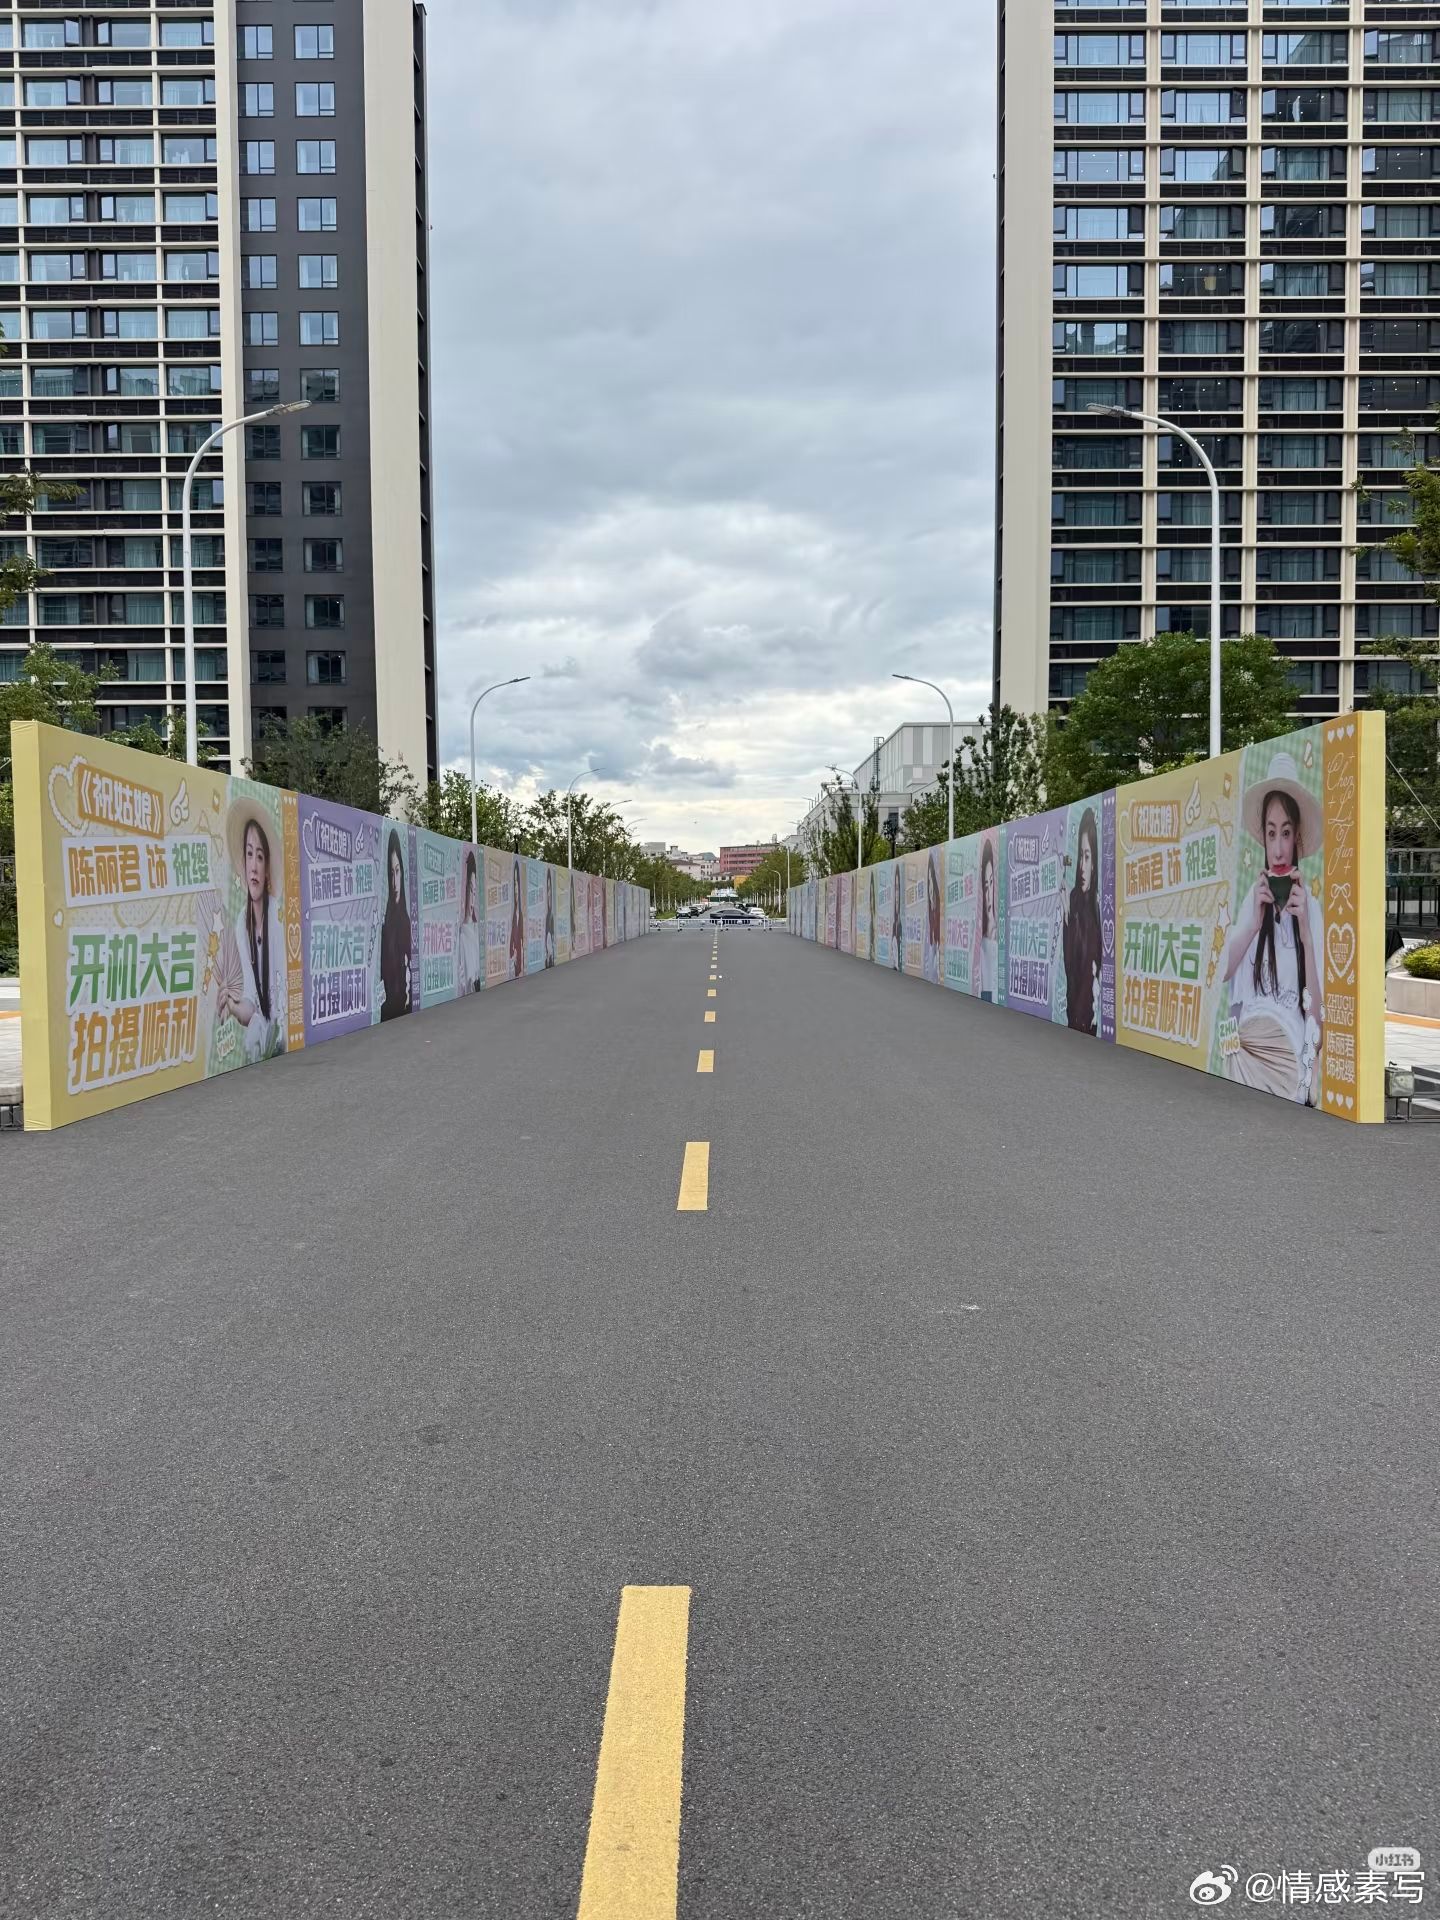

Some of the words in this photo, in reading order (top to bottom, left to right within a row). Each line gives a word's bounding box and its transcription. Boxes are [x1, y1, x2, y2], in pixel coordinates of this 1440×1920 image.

[81, 769, 161, 834] 《祝姑娘》
[1132, 803, 1179, 839] 《祝姑娘》
[68, 844, 141, 897] 陈丽君
[146, 844, 168, 889] 饰
[172, 842, 210, 887] 祝缨
[311, 866, 341, 902] 陈丽君
[1126, 852, 1163, 897] 陈丽君
[1167, 847, 1181, 887] 饰
[1186, 835, 1217, 882] 祝缨
[312, 924, 365, 969] 开机大吉
[1010, 920, 1048, 959] 开机大吉
[1124, 922, 1202, 980] 开机大吉
[70, 932, 196, 1008] 开机大吉
[312, 967, 366, 1021] 拍摄顺利
[1010, 958, 1048, 1001] 拍摄顺利
[1124, 976, 1202, 1042] 拍摄顺利
[1327, 993, 1355, 1012] ZHUGU
[1327, 1009, 1355, 1027] NIANG
[71, 996, 198, 1086] 拍摄顺利
[1326, 1030, 1355, 1058] 陈丽君
